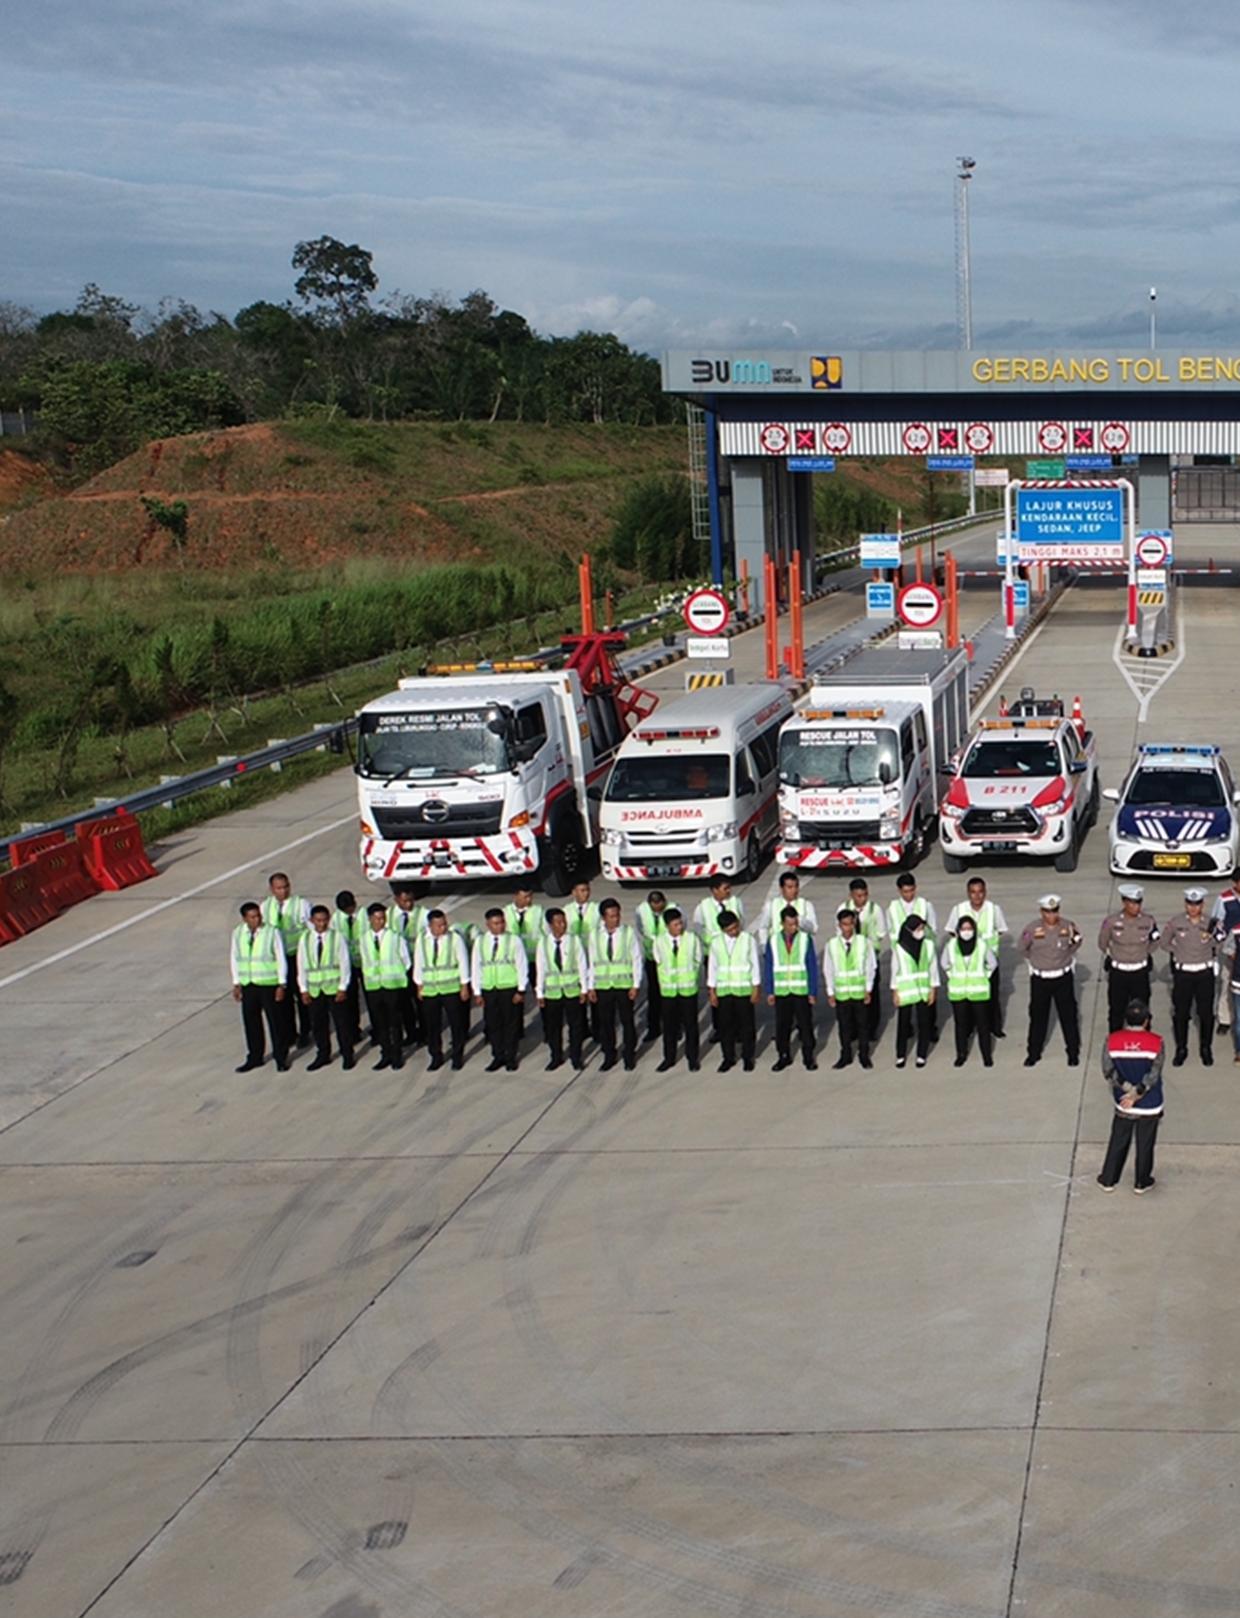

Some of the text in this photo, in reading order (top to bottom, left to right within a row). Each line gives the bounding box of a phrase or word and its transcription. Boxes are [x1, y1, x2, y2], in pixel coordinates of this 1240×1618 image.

[972, 357, 1109, 383] GERBANG
[1116, 357, 1170, 383] TOL
[1025, 501, 1113, 511] LAJUR KHUSUS
[1021, 513, 1083, 522] KENDARAAN
[1077, 524, 1102, 533] JEEP
[1021, 547, 1057, 556] TINGGI
[1061, 547, 1089, 556] MAKS
[379, 713, 481, 725] DEREK RESMI JALAN TOL
[800, 730, 877, 740] RESCUE JALAN TOL
[800, 797, 829, 806] RESCUE
[1134, 810, 1215, 819] POLISI
